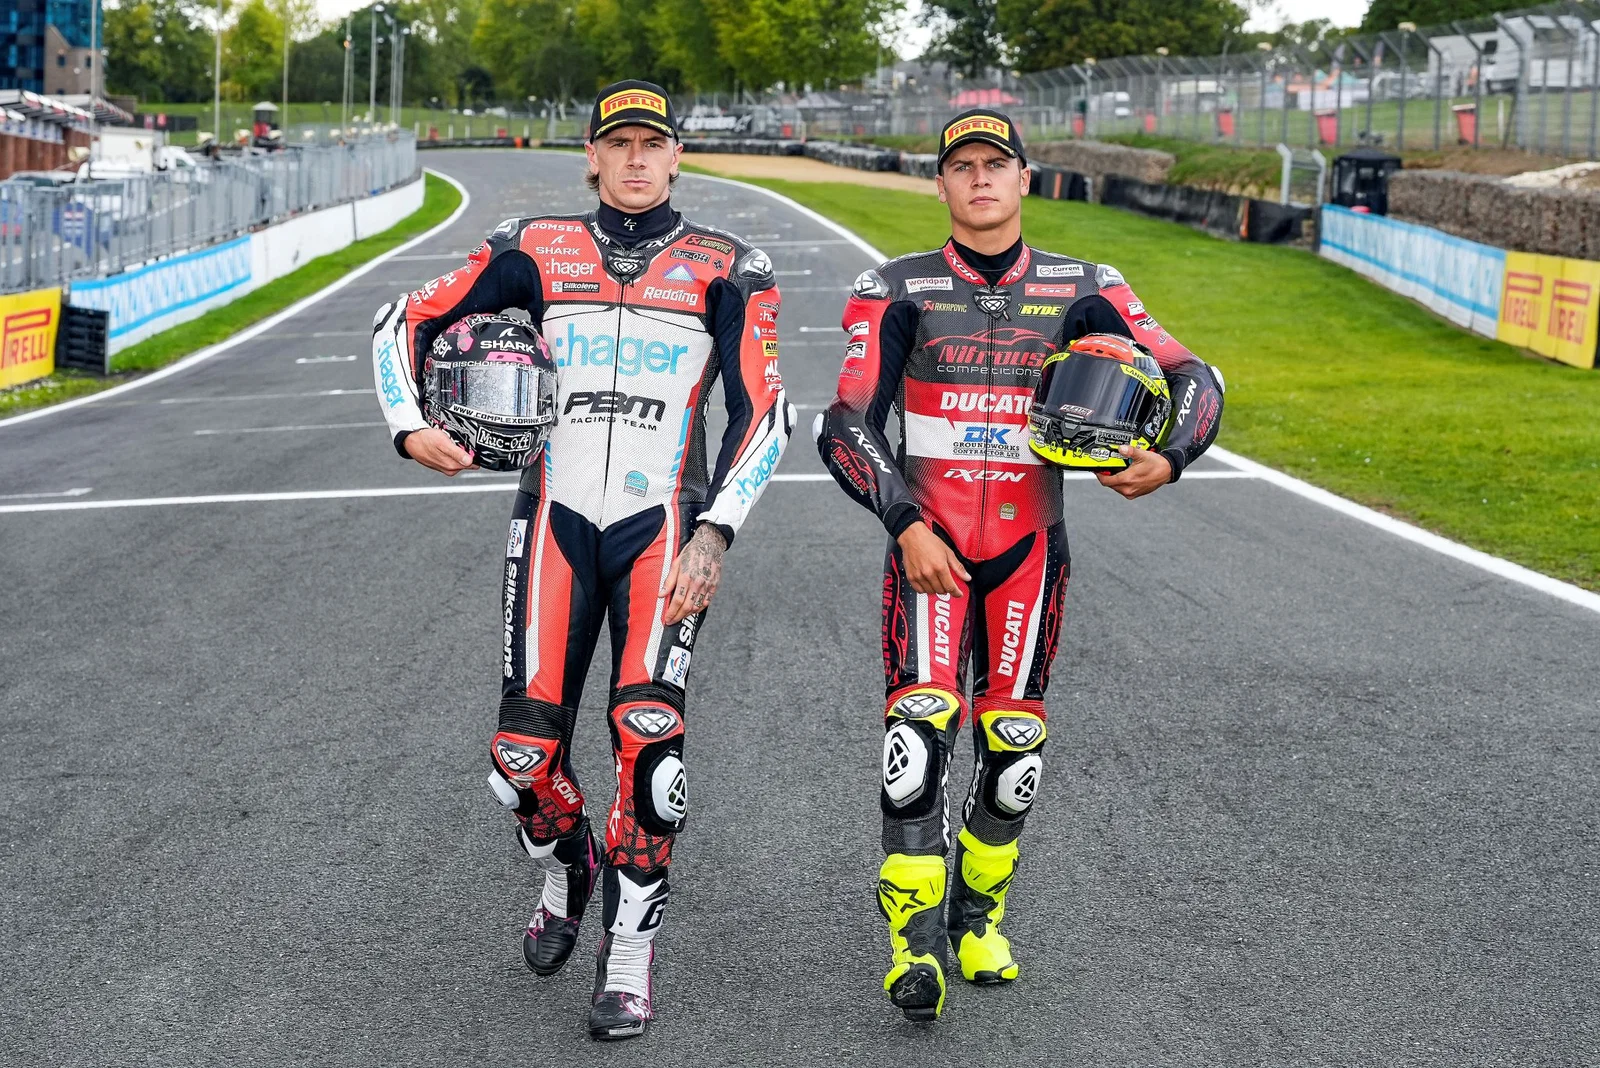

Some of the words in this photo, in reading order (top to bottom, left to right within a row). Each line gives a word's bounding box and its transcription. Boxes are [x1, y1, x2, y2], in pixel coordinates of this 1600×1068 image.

[604, 92, 663, 114] PIRELLI
[947, 118, 1005, 140] PIRELLI
[529, 223, 582, 233] DOMSEA
[536, 246, 580, 255] SHARK
[563, 282, 599, 290] Silkolene
[908, 278, 950, 286] worldpay
[643, 286, 698, 306] Redding
[1020, 306, 1063, 316] RYDE
[1, 308, 51, 370] PIRELLI
[480, 340, 535, 354] SHARK
[938, 345, 1047, 367] Nitrous
[563, 391, 666, 422] PBM
[571, 416, 616, 425] RACING
[623, 418, 657, 431] TEAM
[480, 430, 530, 449] Muc-Off
[953, 441, 1020, 451] GROUNDWORKS
[953, 448, 1004, 456] CONTRACTOR
[510, 521, 518, 554] FUCHS
[504, 561, 518, 678] Silkolene
[934, 592, 951, 667] DUCATI
[997, 600, 1025, 677] DUCATI
[673, 651, 687, 683] FUCHS
